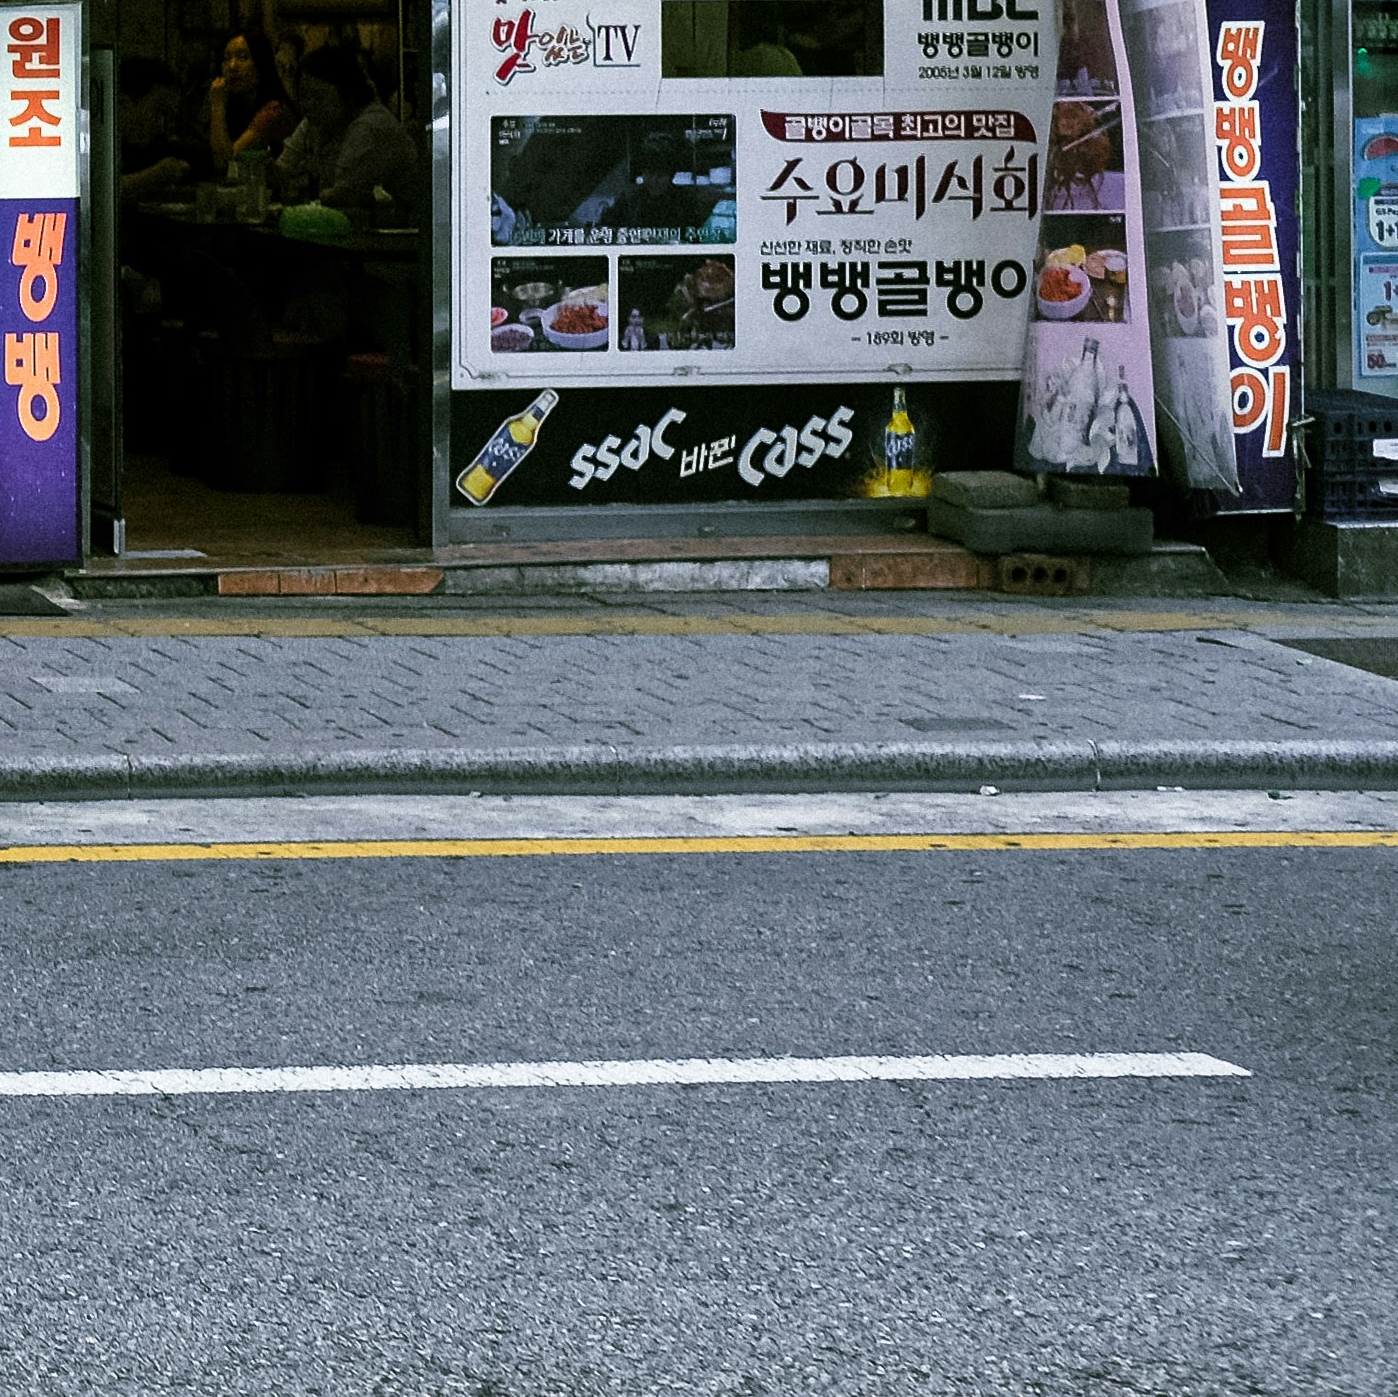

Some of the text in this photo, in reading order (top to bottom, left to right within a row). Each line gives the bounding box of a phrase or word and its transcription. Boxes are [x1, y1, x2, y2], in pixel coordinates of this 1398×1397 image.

[596, 23, 642, 62] TV
[917, 31, 1040, 59] 뱅뱅골뱅이
[7, 16, 63, 148] 원조
[900, 113, 966, 139] 최고의
[971, 113, 1015, 139] 맛집
[759, 145, 1039, 226] 수요미식회
[4, 212, 67, 442] 뱅뱅
